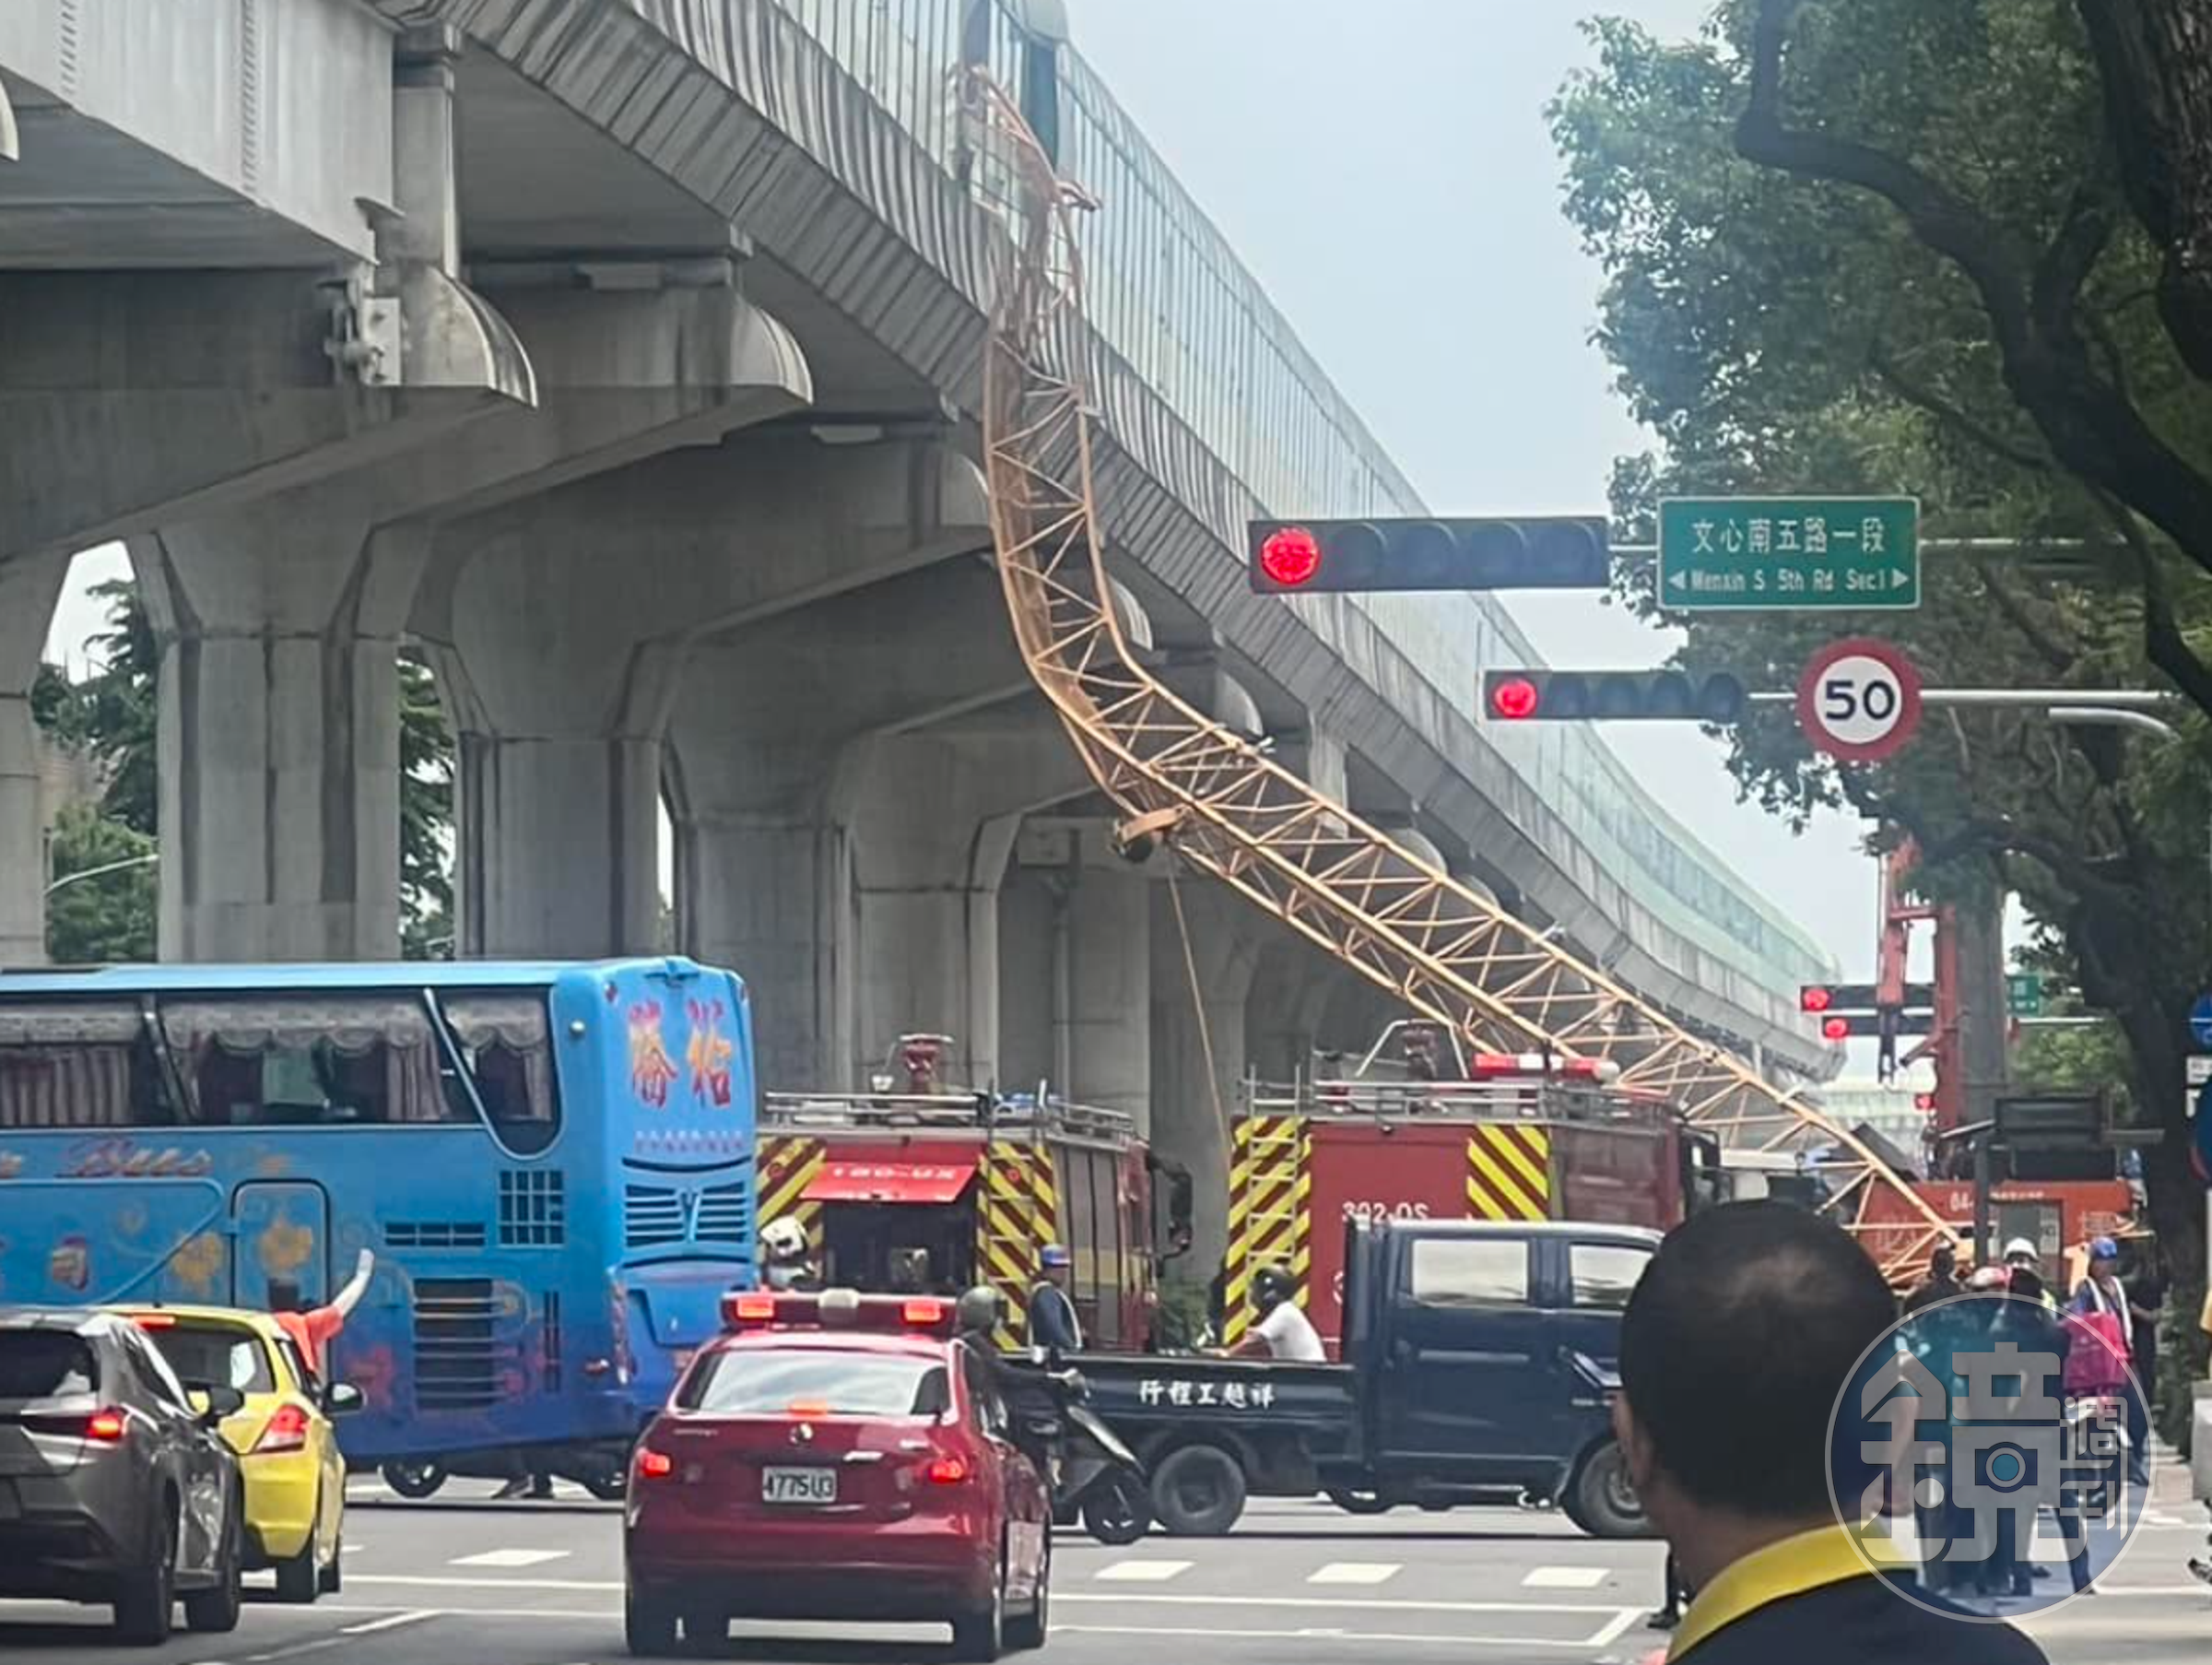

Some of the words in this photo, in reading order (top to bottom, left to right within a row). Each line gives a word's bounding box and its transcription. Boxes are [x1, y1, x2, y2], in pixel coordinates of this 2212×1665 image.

[1691, 517, 1885, 554] 文心南五路一段
[1753, 569, 1766, 591] S
[1777, 568, 1805, 591] 5th
[1813, 568, 1835, 591] Rd
[1825, 679, 1896, 720] 50
